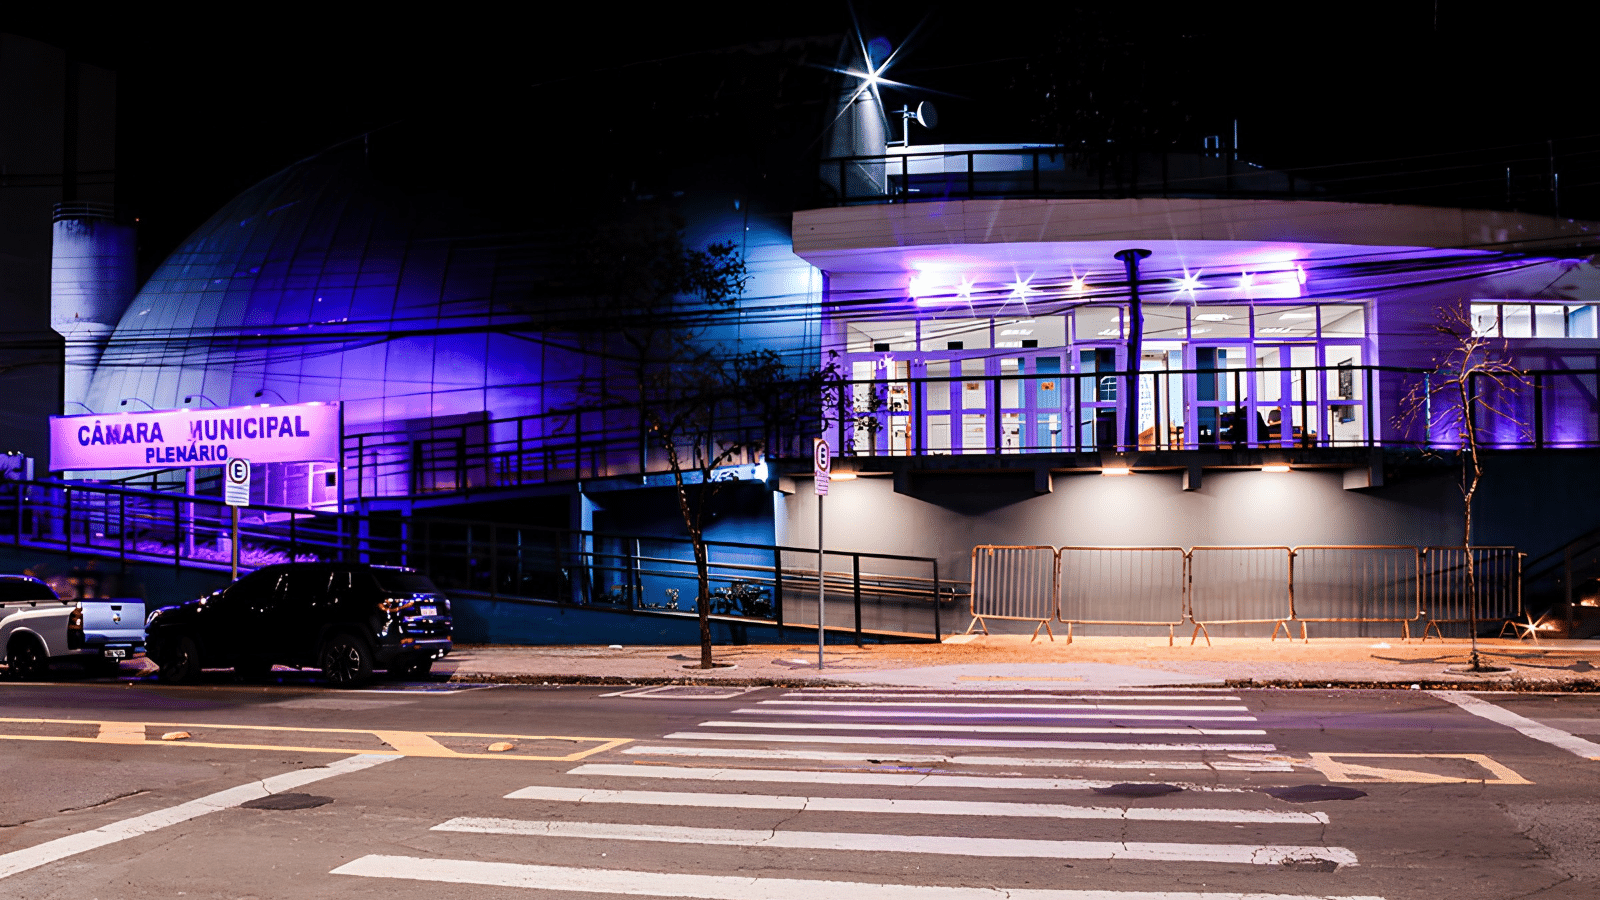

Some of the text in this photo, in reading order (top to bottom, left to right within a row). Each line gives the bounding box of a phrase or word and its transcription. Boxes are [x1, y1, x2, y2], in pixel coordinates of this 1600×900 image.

[78, 419, 164, 446] CÂMARA
[146, 440, 228, 463] PLENÁRIO
[820, 447, 826, 465] E
[234, 463, 243, 479] E
